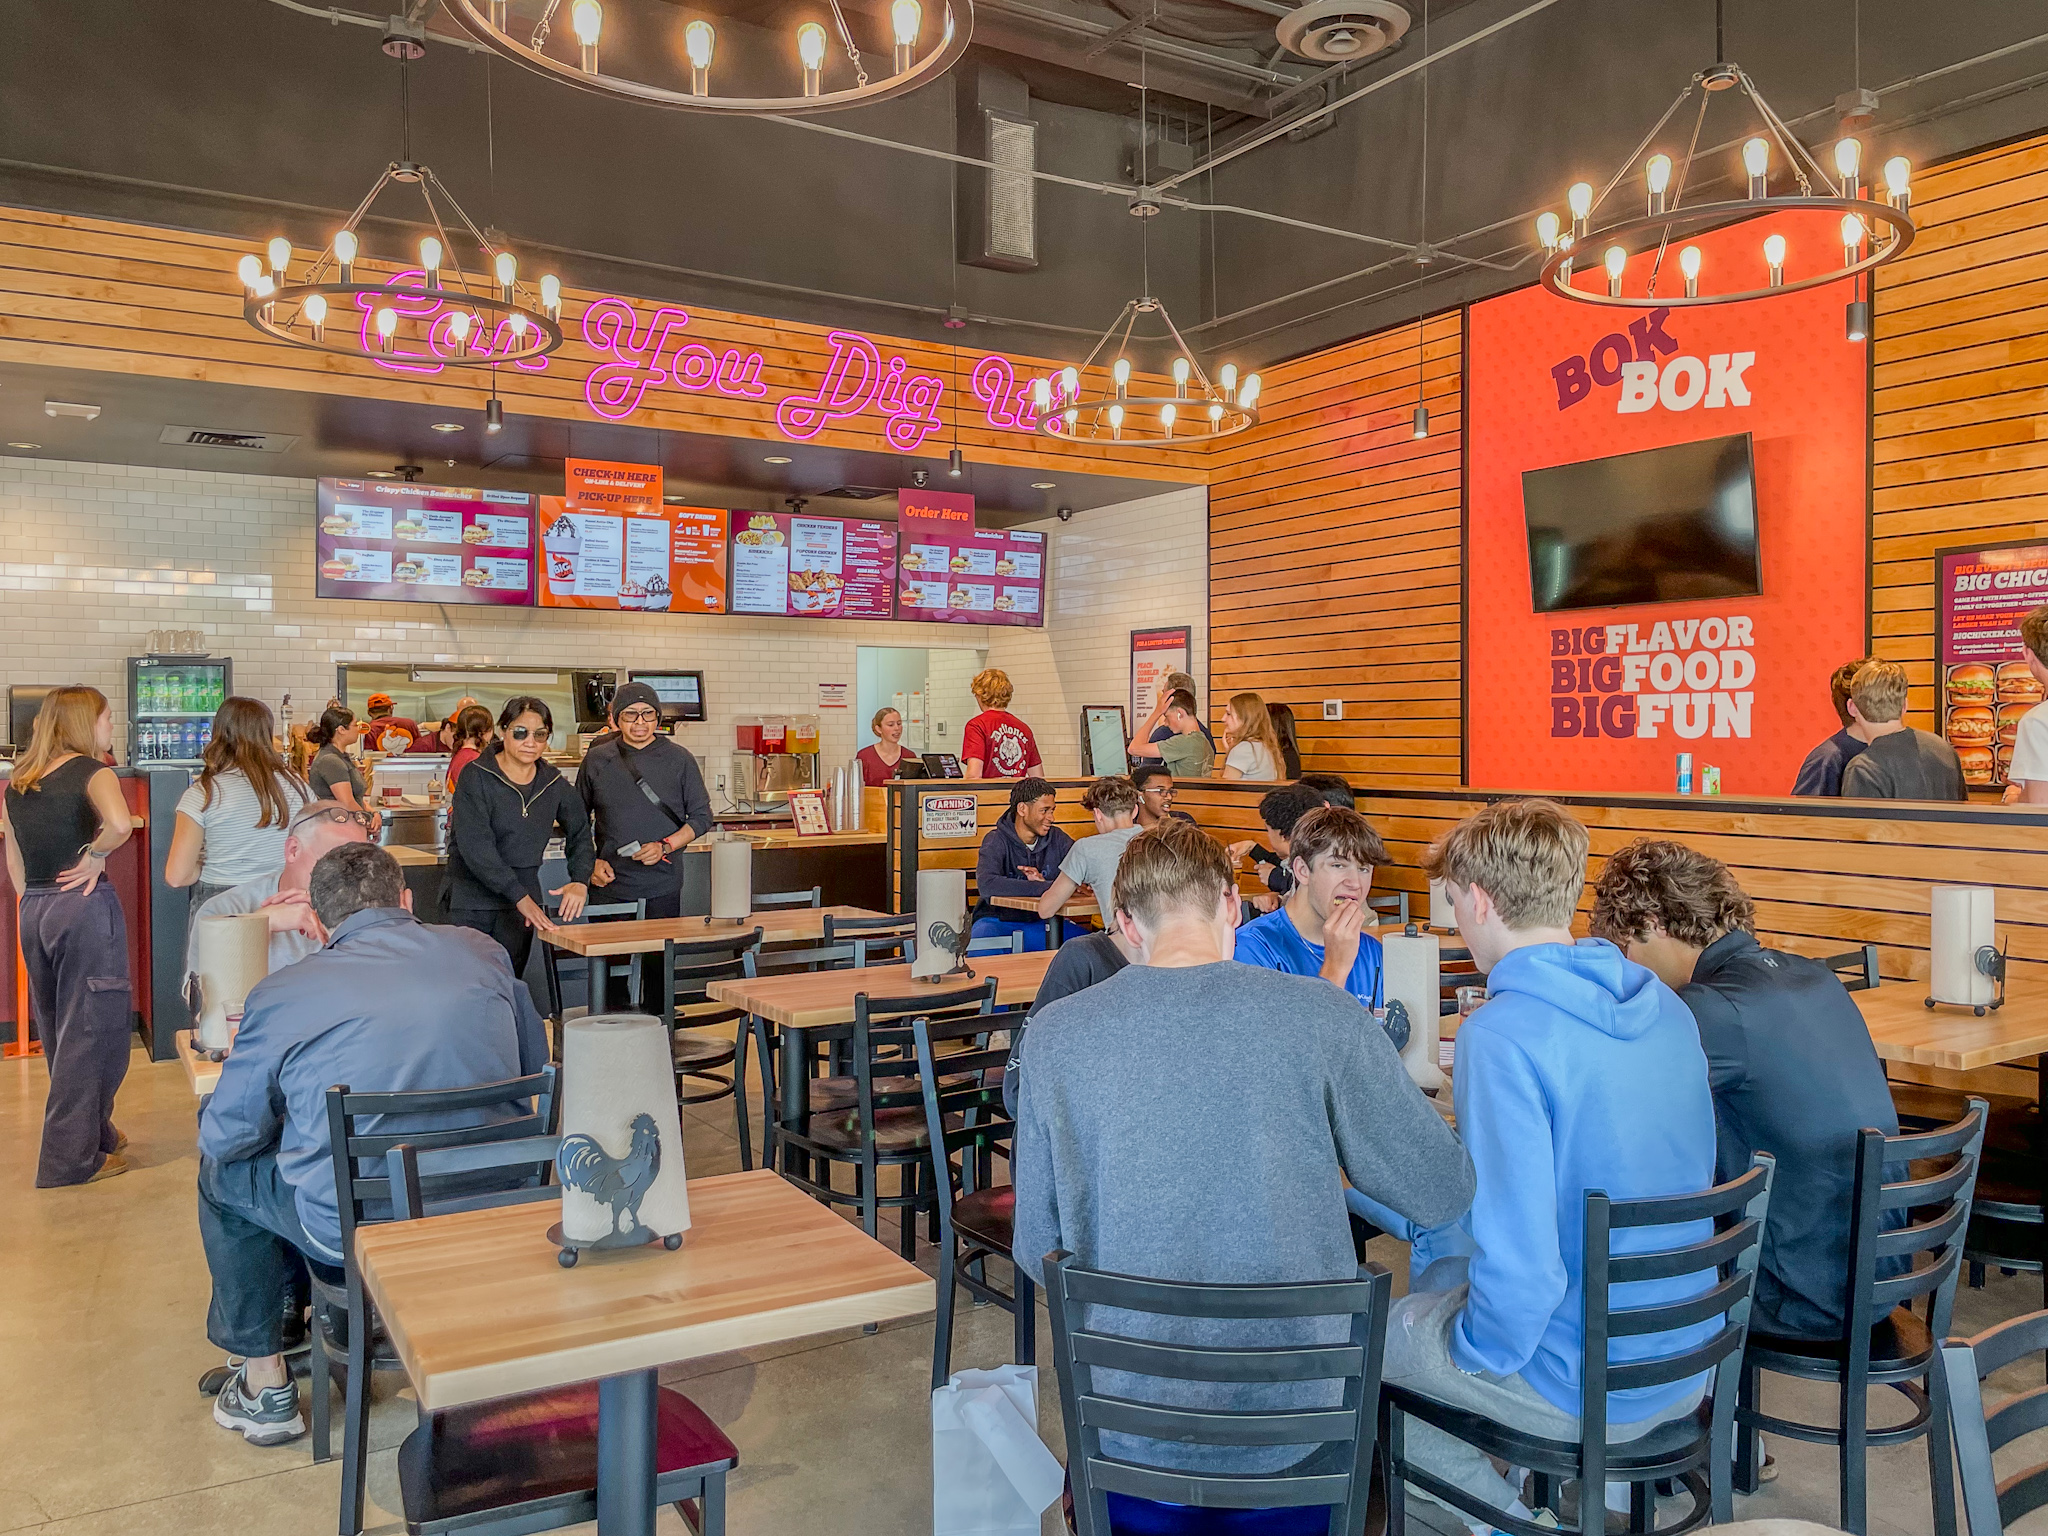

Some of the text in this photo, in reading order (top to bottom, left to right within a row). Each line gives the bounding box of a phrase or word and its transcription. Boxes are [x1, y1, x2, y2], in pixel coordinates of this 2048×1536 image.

[356, 270, 549, 374] Can
[583, 298, 768, 420] You
[776, 331, 944, 451] Dig
[1551, 306, 1679, 412] BOK
[1617, 351, 1756, 414] BOK
[573, 467, 657, 482] CHECK-IN HERE
[615, 480, 646, 488] DELIVERY
[375, 485, 473, 500] Crispy Chicken Sandwiches
[578, 491, 653, 505] PICK-UP HERE
[905, 505, 969, 521] Order Here
[554, 562, 570, 574] BIG
[1954, 565, 1974, 575] BIG
[1954, 569, 2048, 592] BIG CHIC
[704, 596, 718, 605] BIG
[1551, 616, 1755, 656] BIG FLAVOR
[1551, 650, 1756, 694] BIG FOOD
[1551, 691, 1755, 739] BIG FUN
[990, 723, 1029, 744] Deftones
[929, 799, 969, 809] WARNING
[925, 823, 959, 831] CHICKENS
